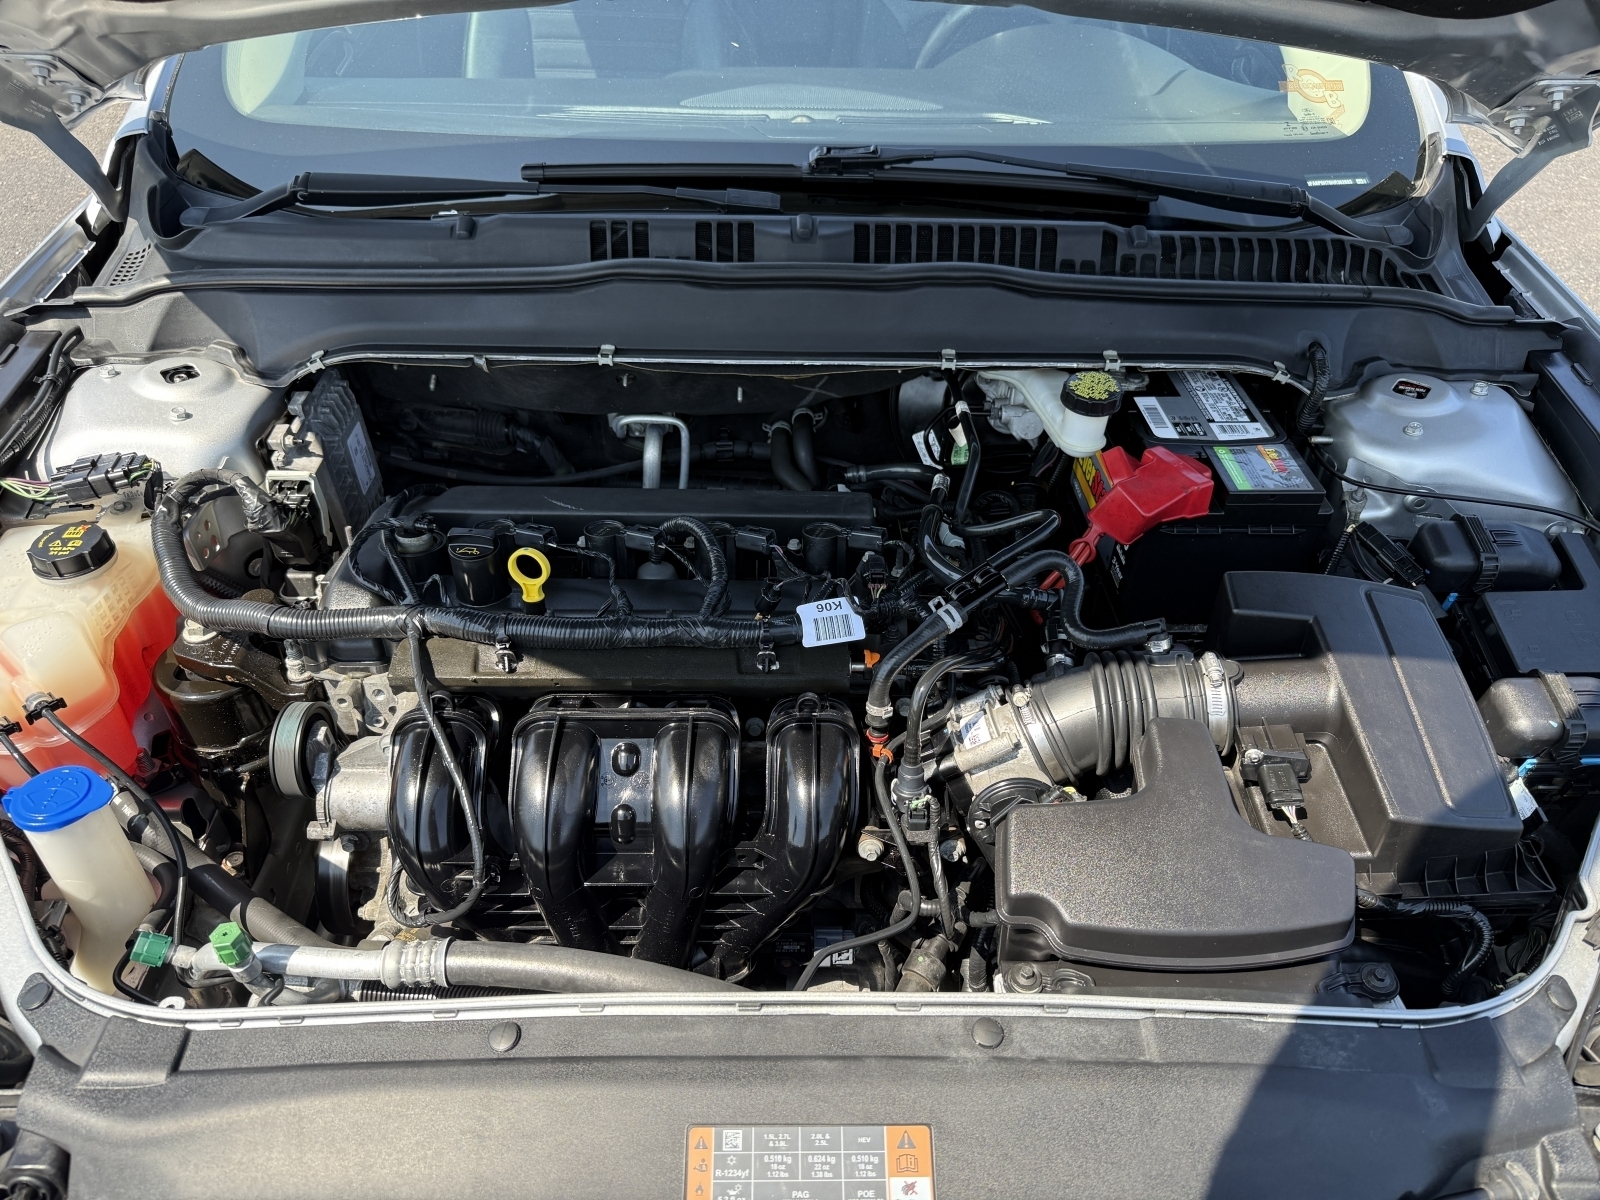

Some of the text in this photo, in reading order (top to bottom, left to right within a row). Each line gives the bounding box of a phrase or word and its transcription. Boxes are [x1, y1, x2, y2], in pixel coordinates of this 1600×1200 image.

[816, 601, 842, 612] K06
[783, 1154, 792, 1164] kg
[807, 1154, 836, 1164] 0.624 kg
[851, 1154, 879, 1164] 0.510 kg
[715, 1169, 750, 1179] R-1234yf
[780, 1170, 789, 1178] lbs
[823, 1170, 833, 1178] lbs
[867, 1170, 876, 1178] lbs
[792, 1190, 810, 1198] PAG
[857, 1190, 875, 1198] POE
